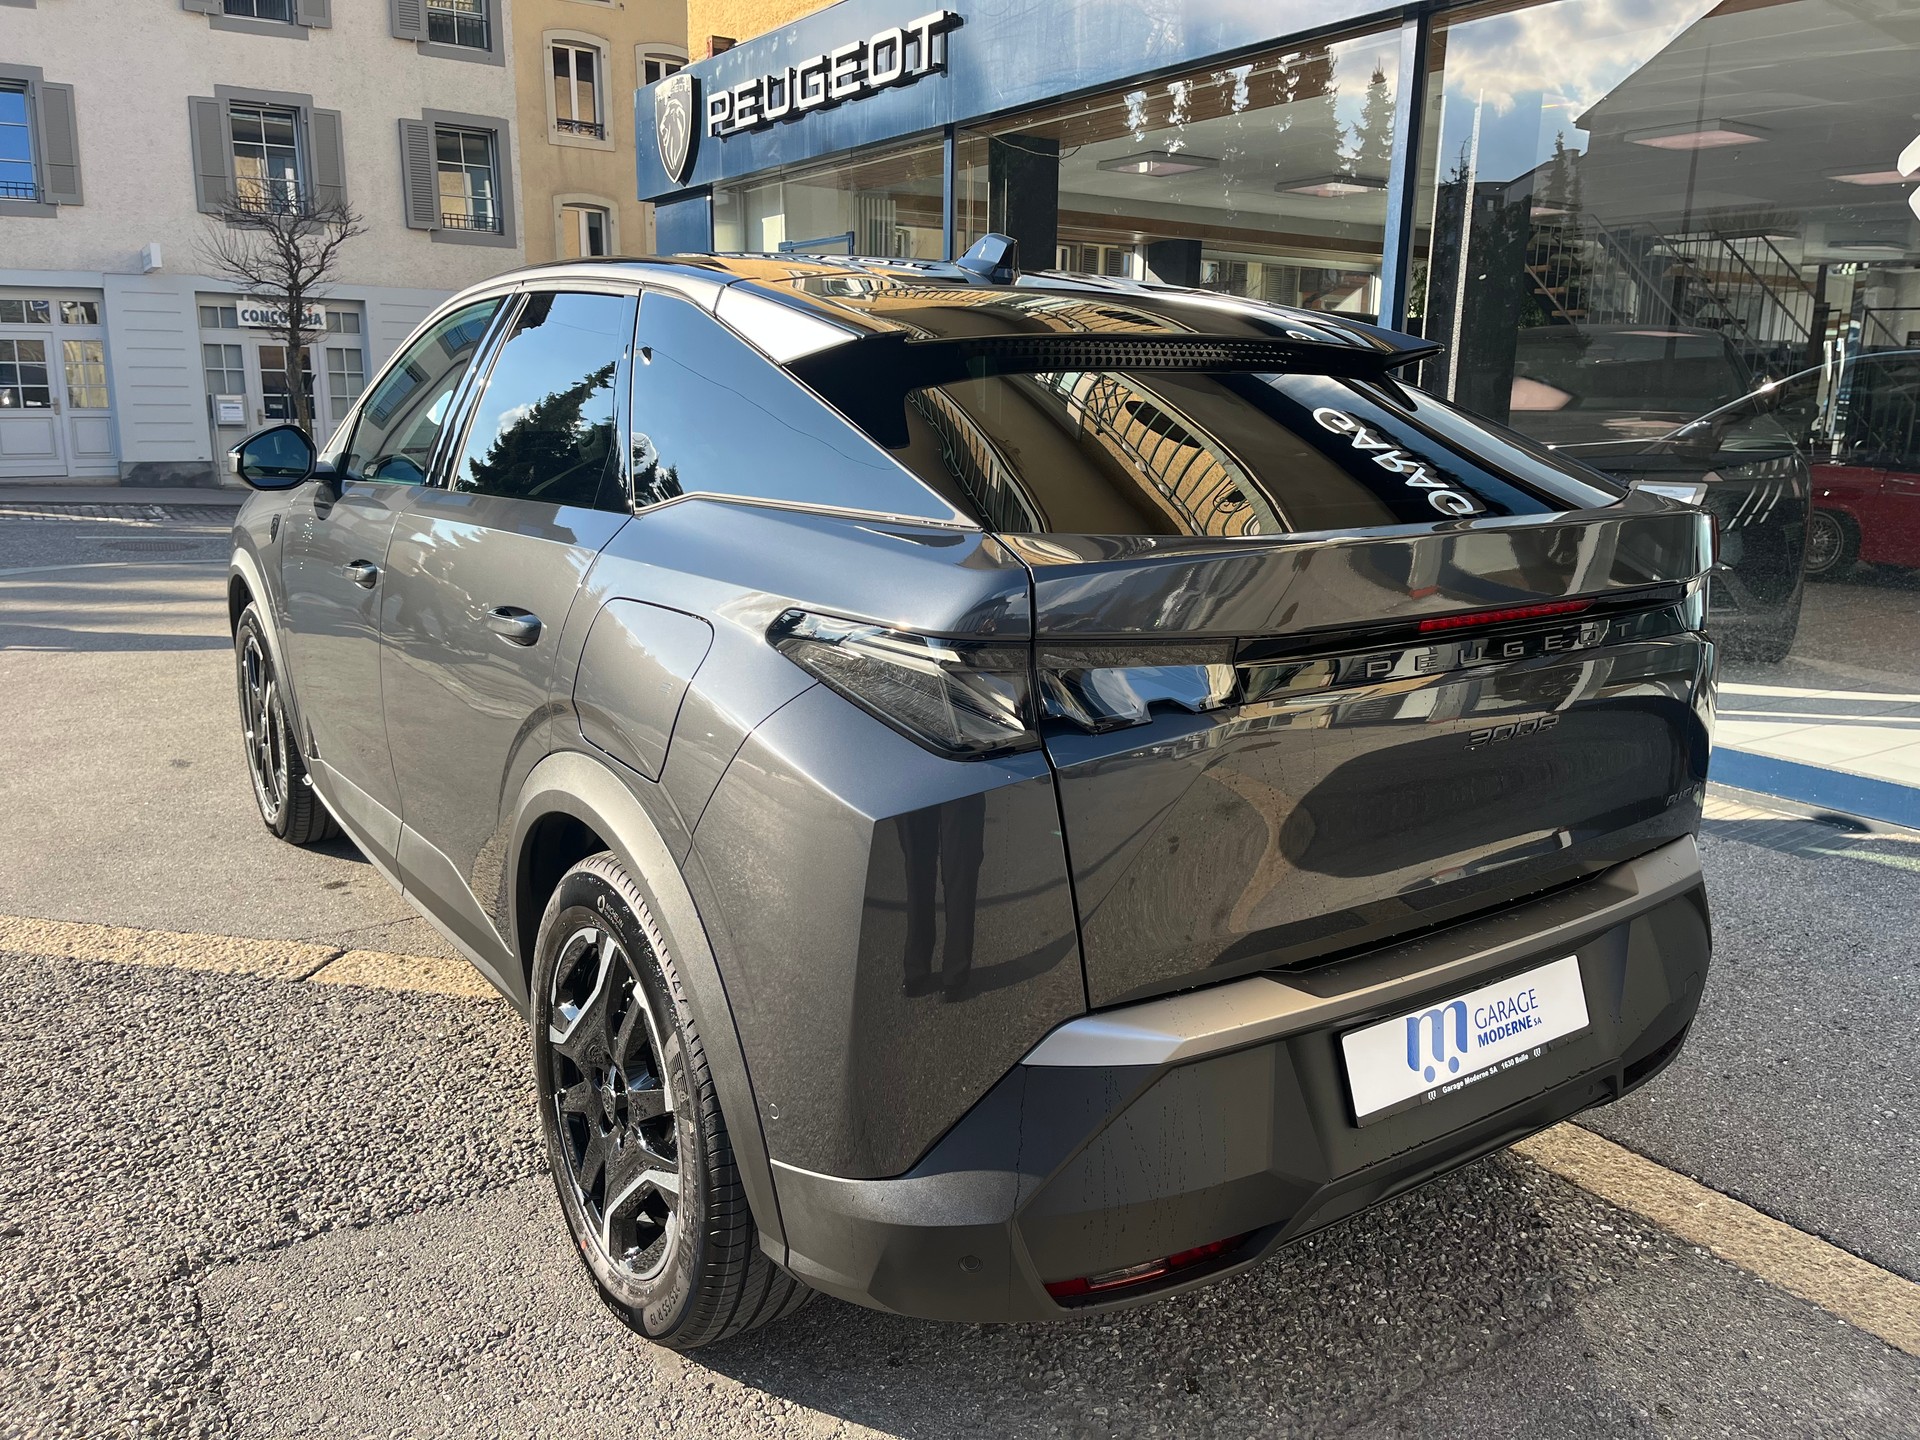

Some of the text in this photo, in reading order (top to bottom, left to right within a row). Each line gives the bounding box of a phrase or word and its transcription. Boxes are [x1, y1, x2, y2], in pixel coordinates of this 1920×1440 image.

[707, 10, 947, 138] PEUGEOT
[241, 308, 323, 326] CONCODIA
[1366, 622, 1635, 678] PEUGEOT
[1464, 715, 1559, 750] 3008
[1474, 988, 1539, 1030] GARAGE
[1477, 1015, 1543, 1048] MODERNE SA
[1442, 1053, 1529, 1094] Garage Moderne SA 1630 Bulle
